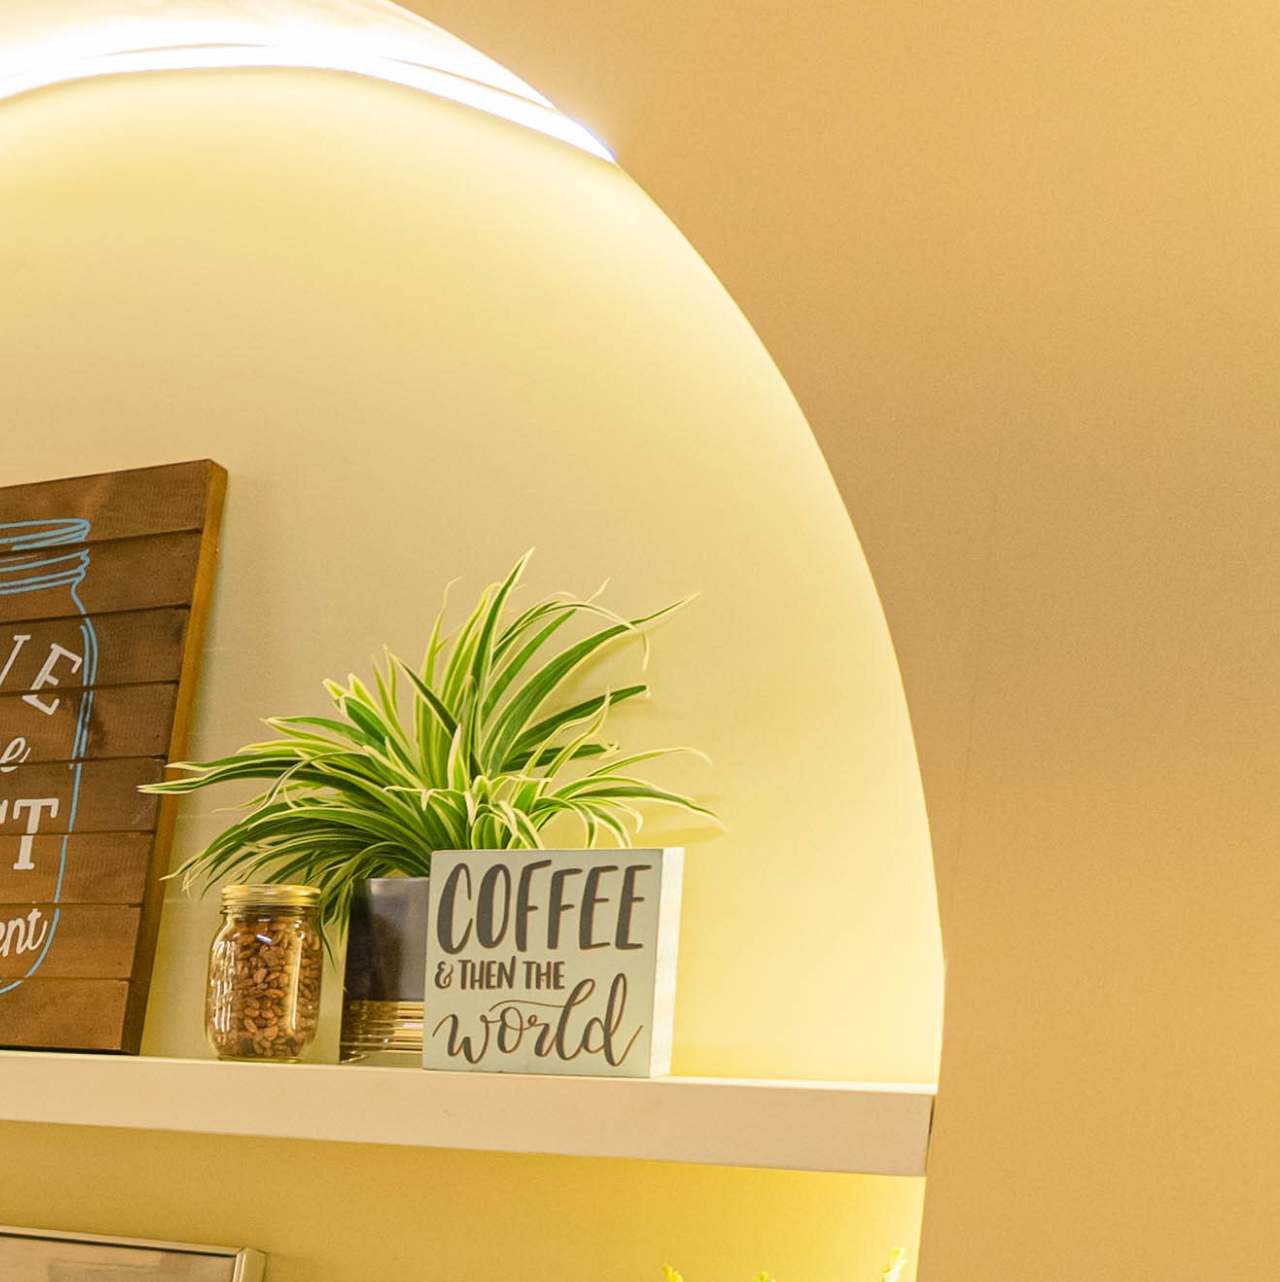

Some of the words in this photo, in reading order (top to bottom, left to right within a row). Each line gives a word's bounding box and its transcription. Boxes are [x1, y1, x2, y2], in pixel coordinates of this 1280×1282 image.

[436, 859, 652, 954] COFFEE
[432, 972, 644, 1067] world
[434, 960, 454, 989] &
[458, 956, 516, 990] THEN
[522, 960, 566, 990] THE
